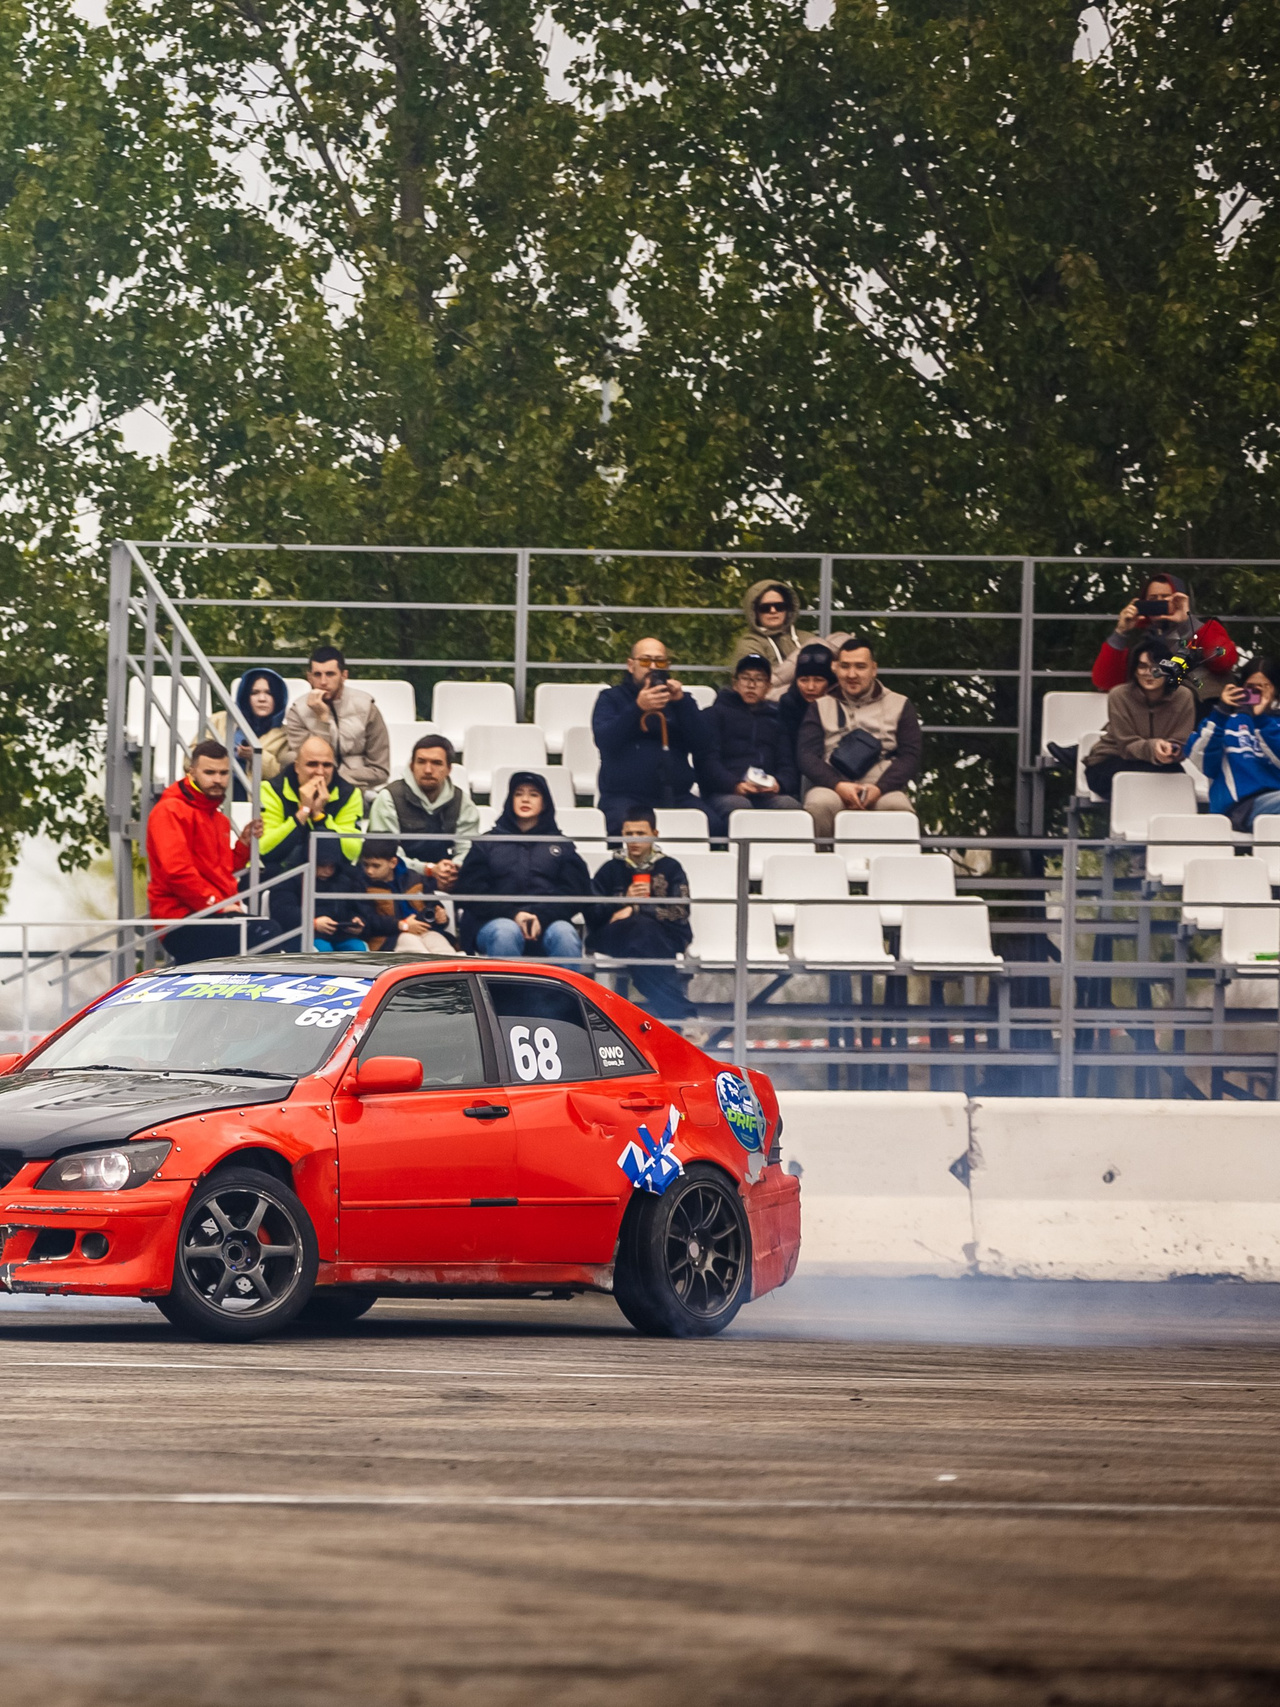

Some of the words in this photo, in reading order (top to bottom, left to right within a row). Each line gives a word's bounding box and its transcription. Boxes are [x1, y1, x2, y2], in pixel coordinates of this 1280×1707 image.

[294, 1006, 349, 1029] 68
[509, 1025, 563, 1082] 68
[599, 1046, 624, 1059] OWO
[727, 1107, 758, 1133] DRIF
